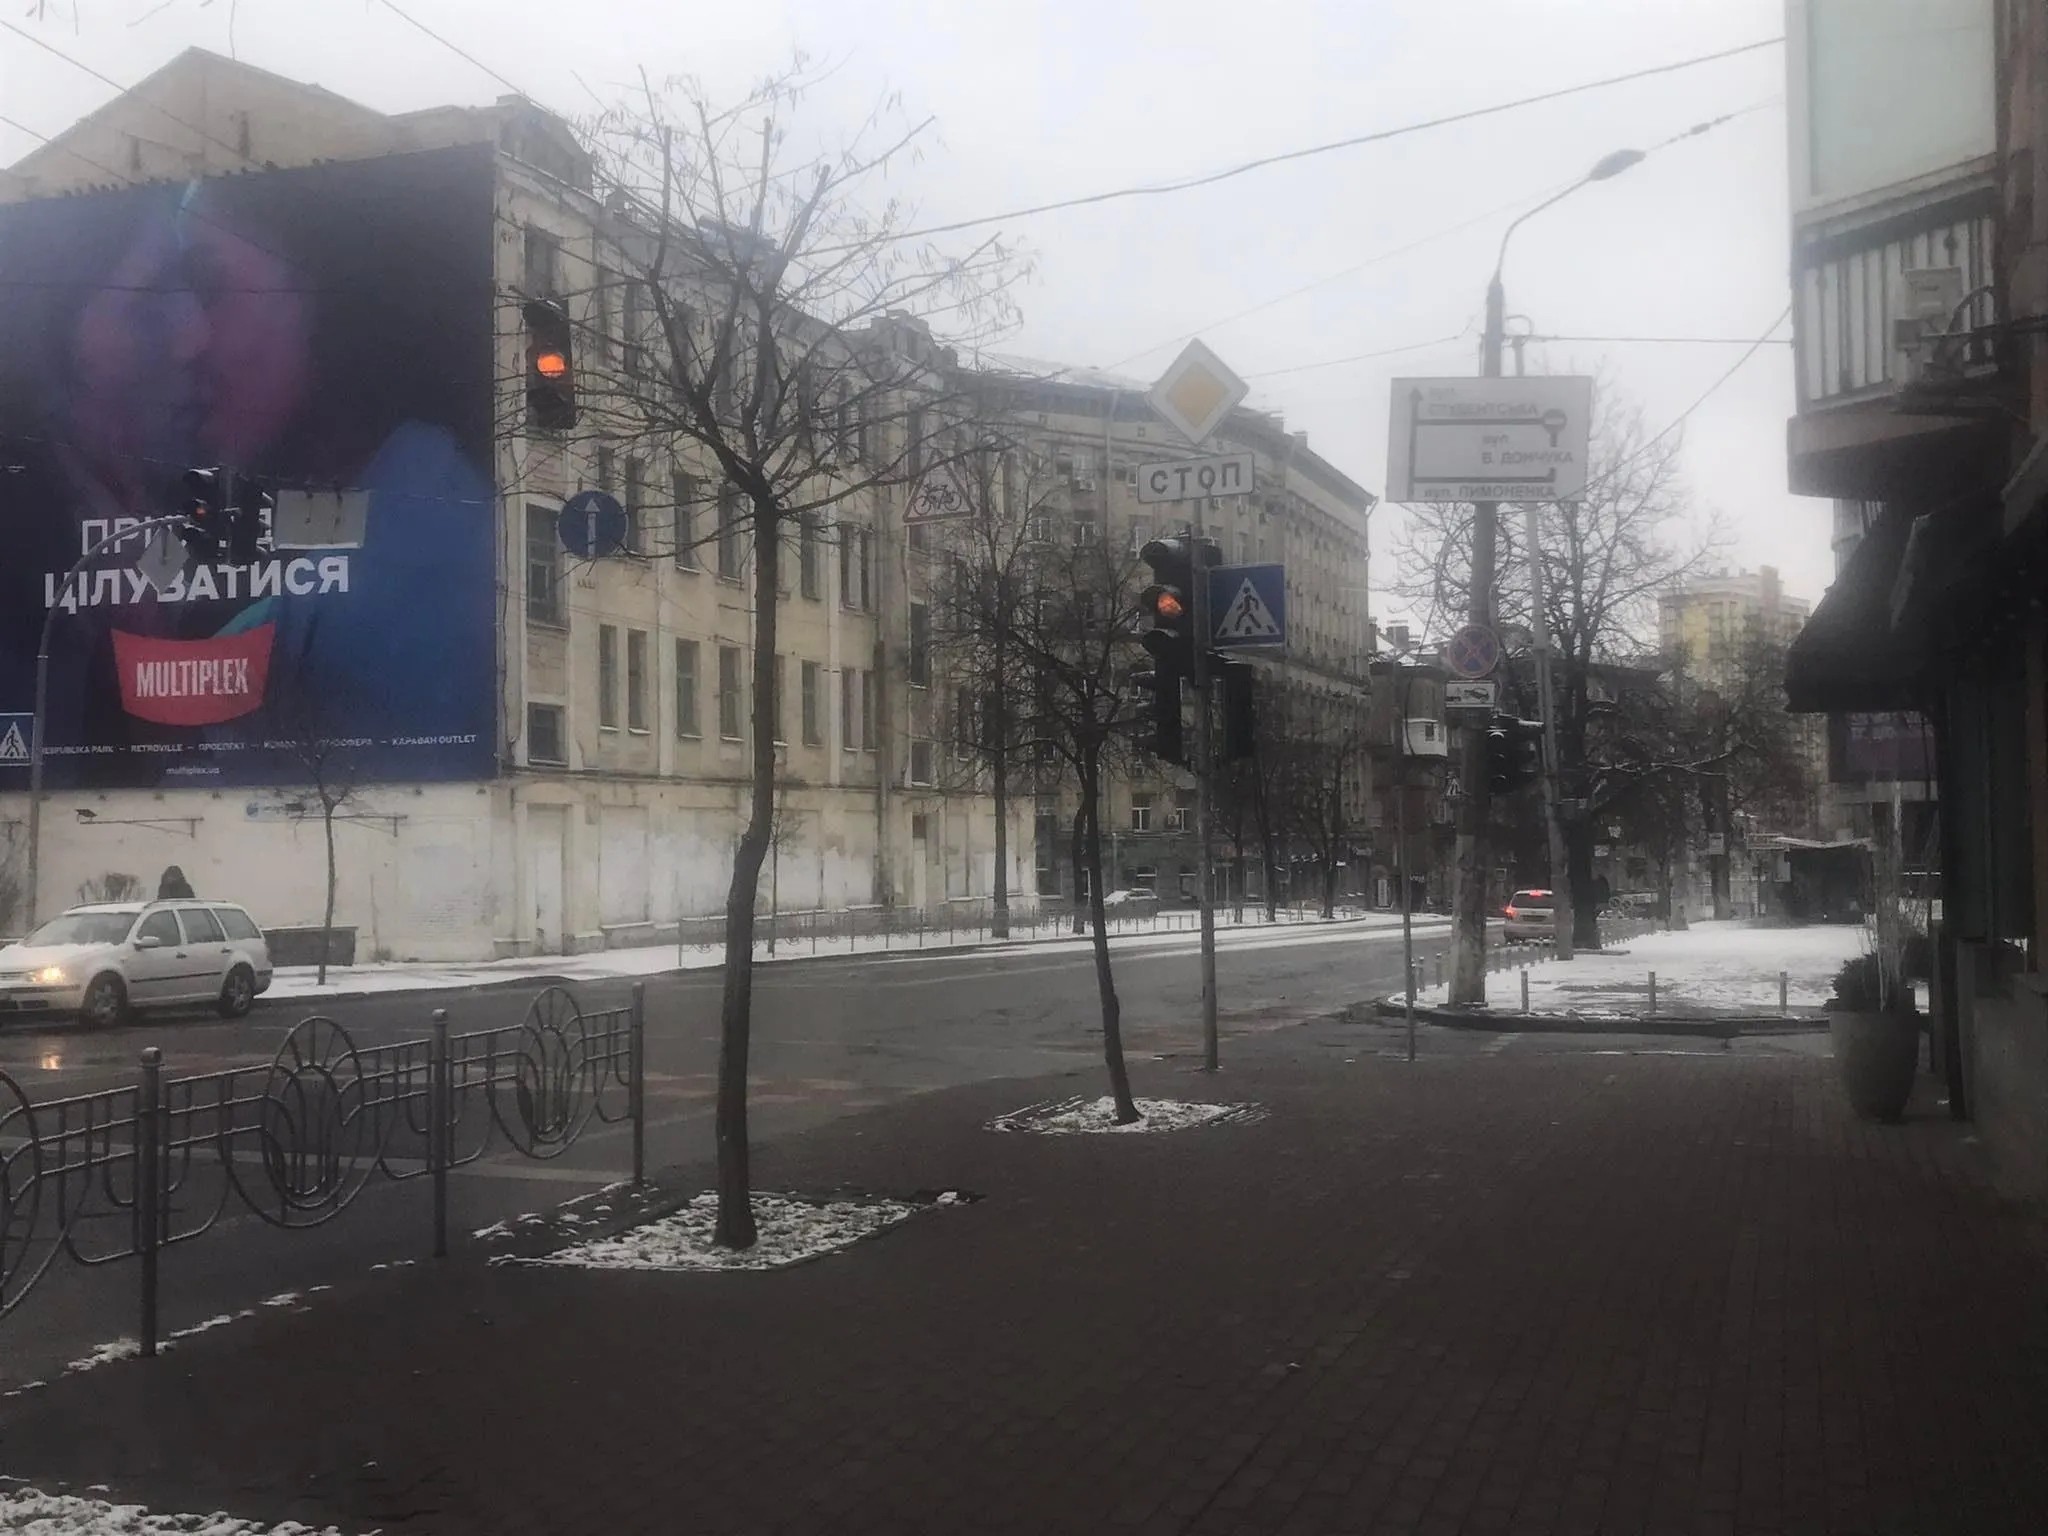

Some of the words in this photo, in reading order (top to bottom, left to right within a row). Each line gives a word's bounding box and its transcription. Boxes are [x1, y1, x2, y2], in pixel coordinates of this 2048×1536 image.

[1150, 462, 1240, 495] СТОП
[44, 556, 349, 615] ЦІЛУВАТИСЯ
[136, 658, 249, 698] MULTIPLEX
